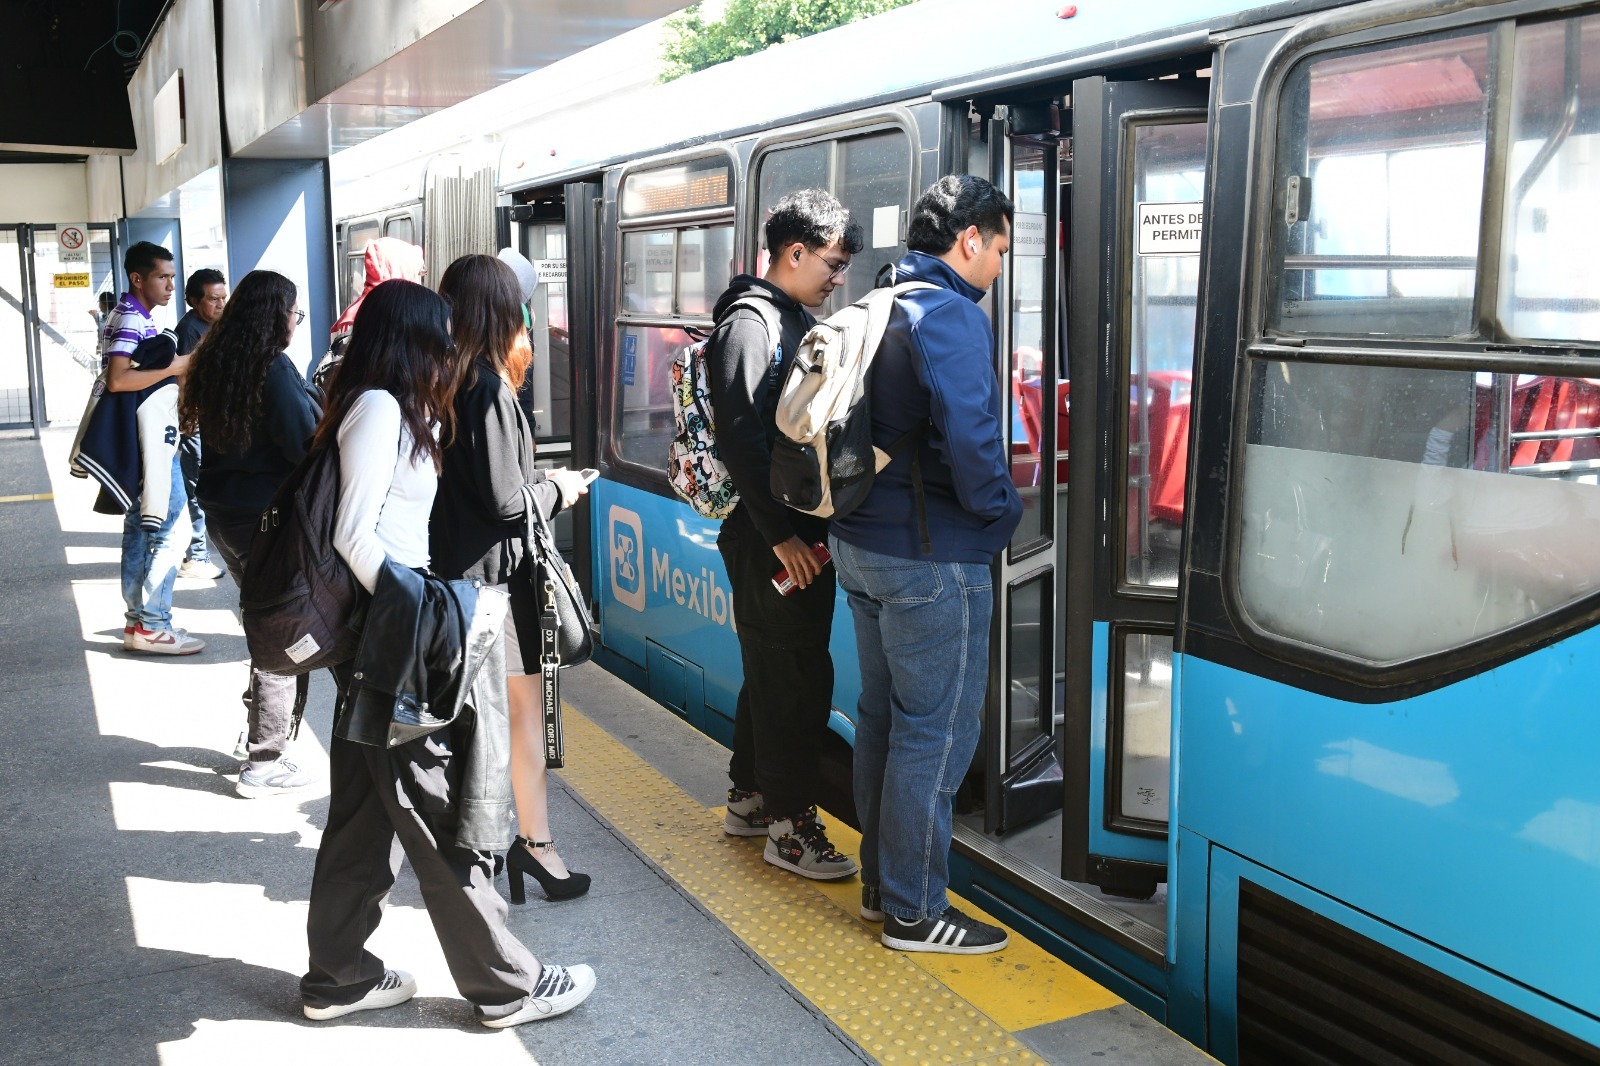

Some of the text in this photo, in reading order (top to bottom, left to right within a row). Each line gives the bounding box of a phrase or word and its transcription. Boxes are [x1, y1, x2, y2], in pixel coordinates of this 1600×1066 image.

[1143, 213, 1203, 225] ANTES DE
[1152, 229, 1201, 240] PERMIT
[545, 680, 554, 716] MICHAEL
[546, 723, 555, 744] KORS
